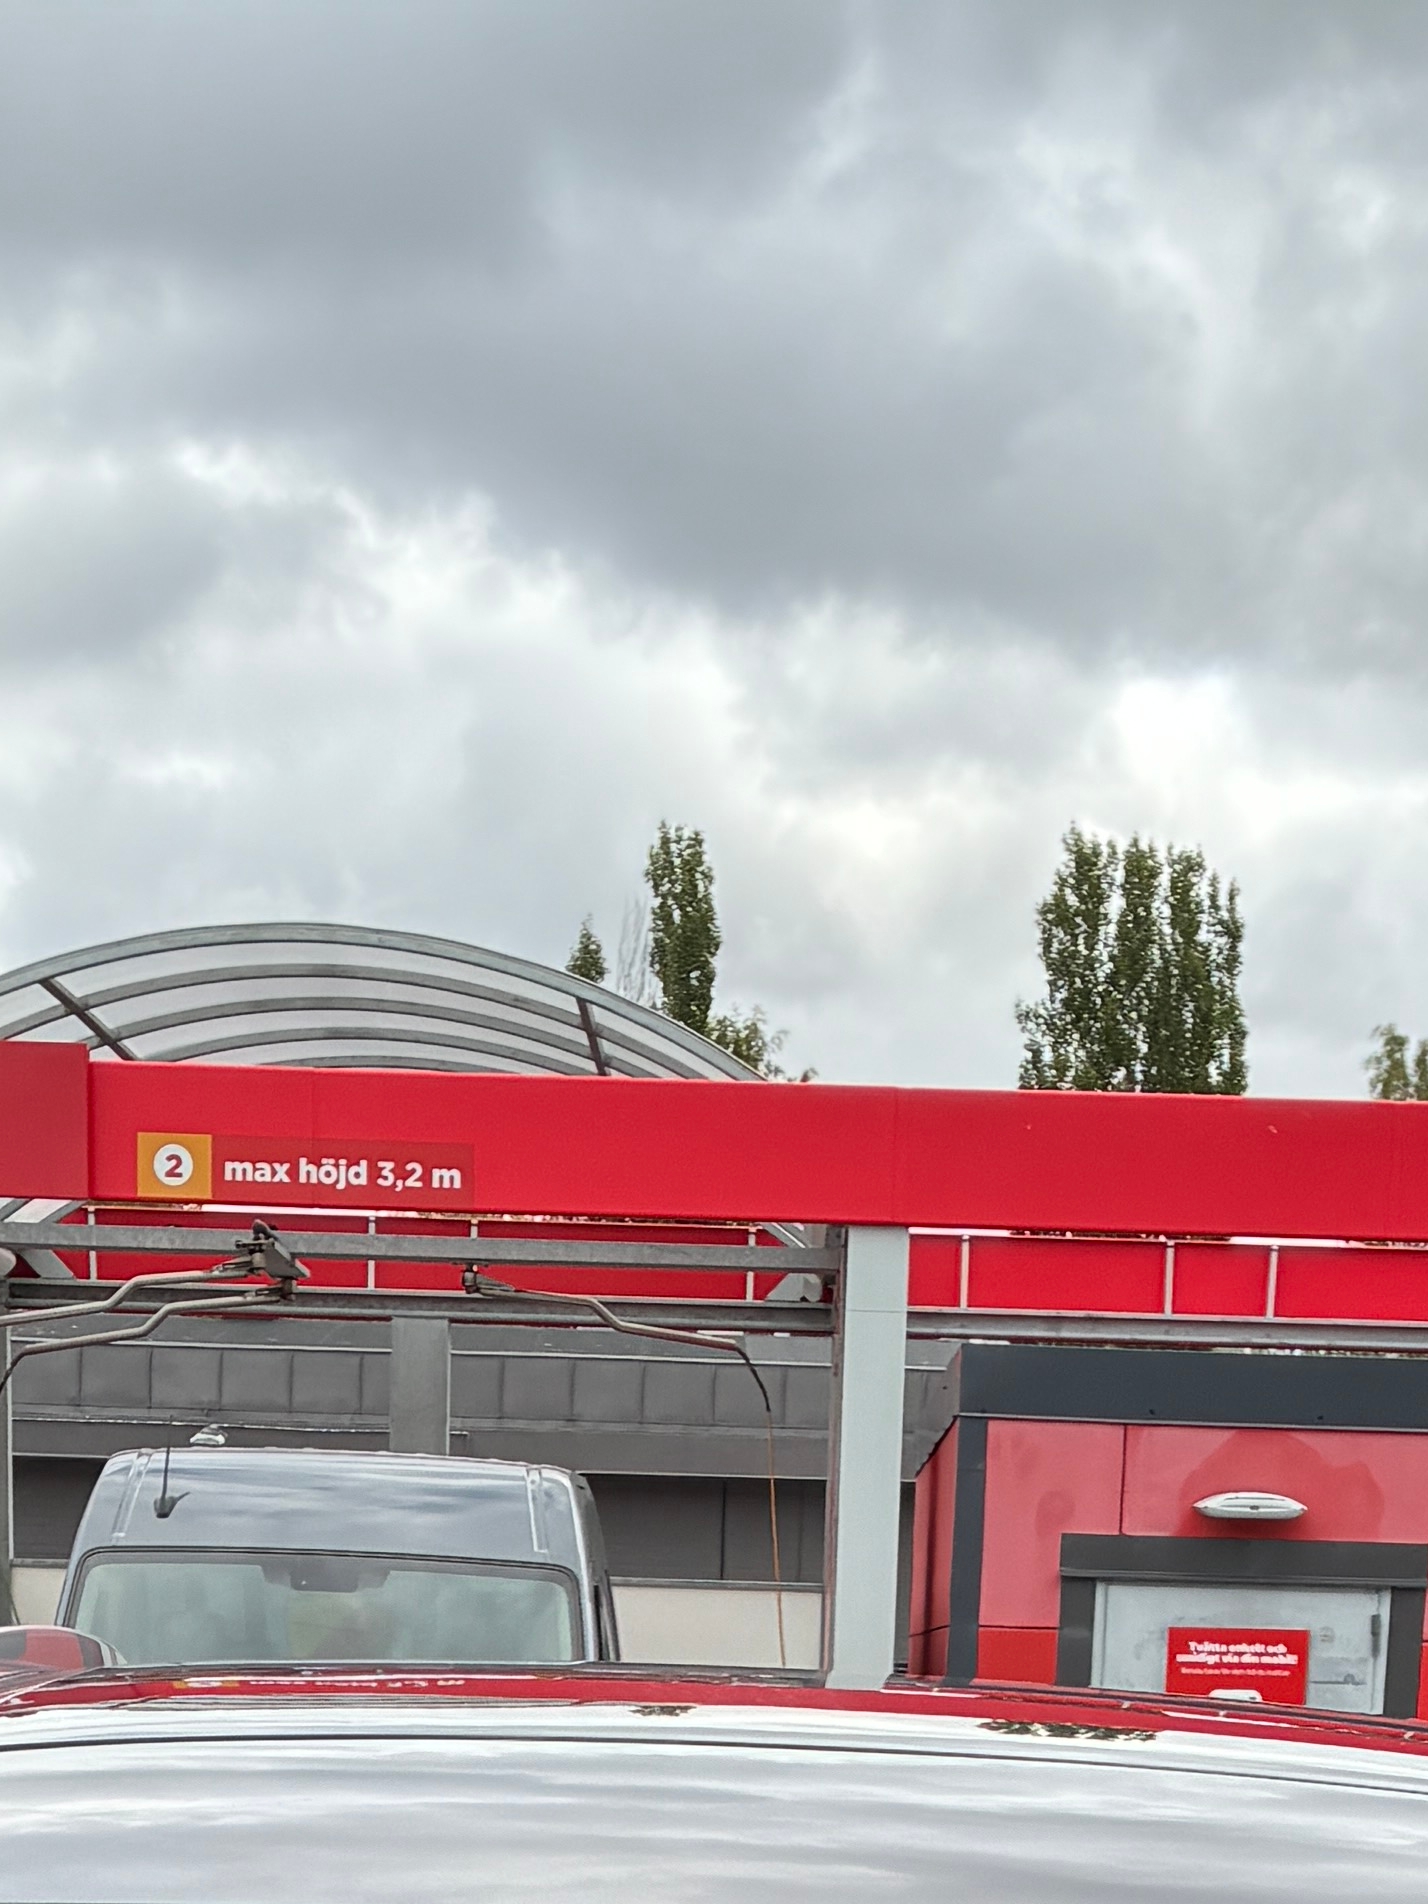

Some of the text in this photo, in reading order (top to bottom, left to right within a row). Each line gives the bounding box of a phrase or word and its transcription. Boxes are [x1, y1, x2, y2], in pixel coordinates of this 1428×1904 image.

[164, 1153, 462, 1191] 2 max höjd 3,2 m
